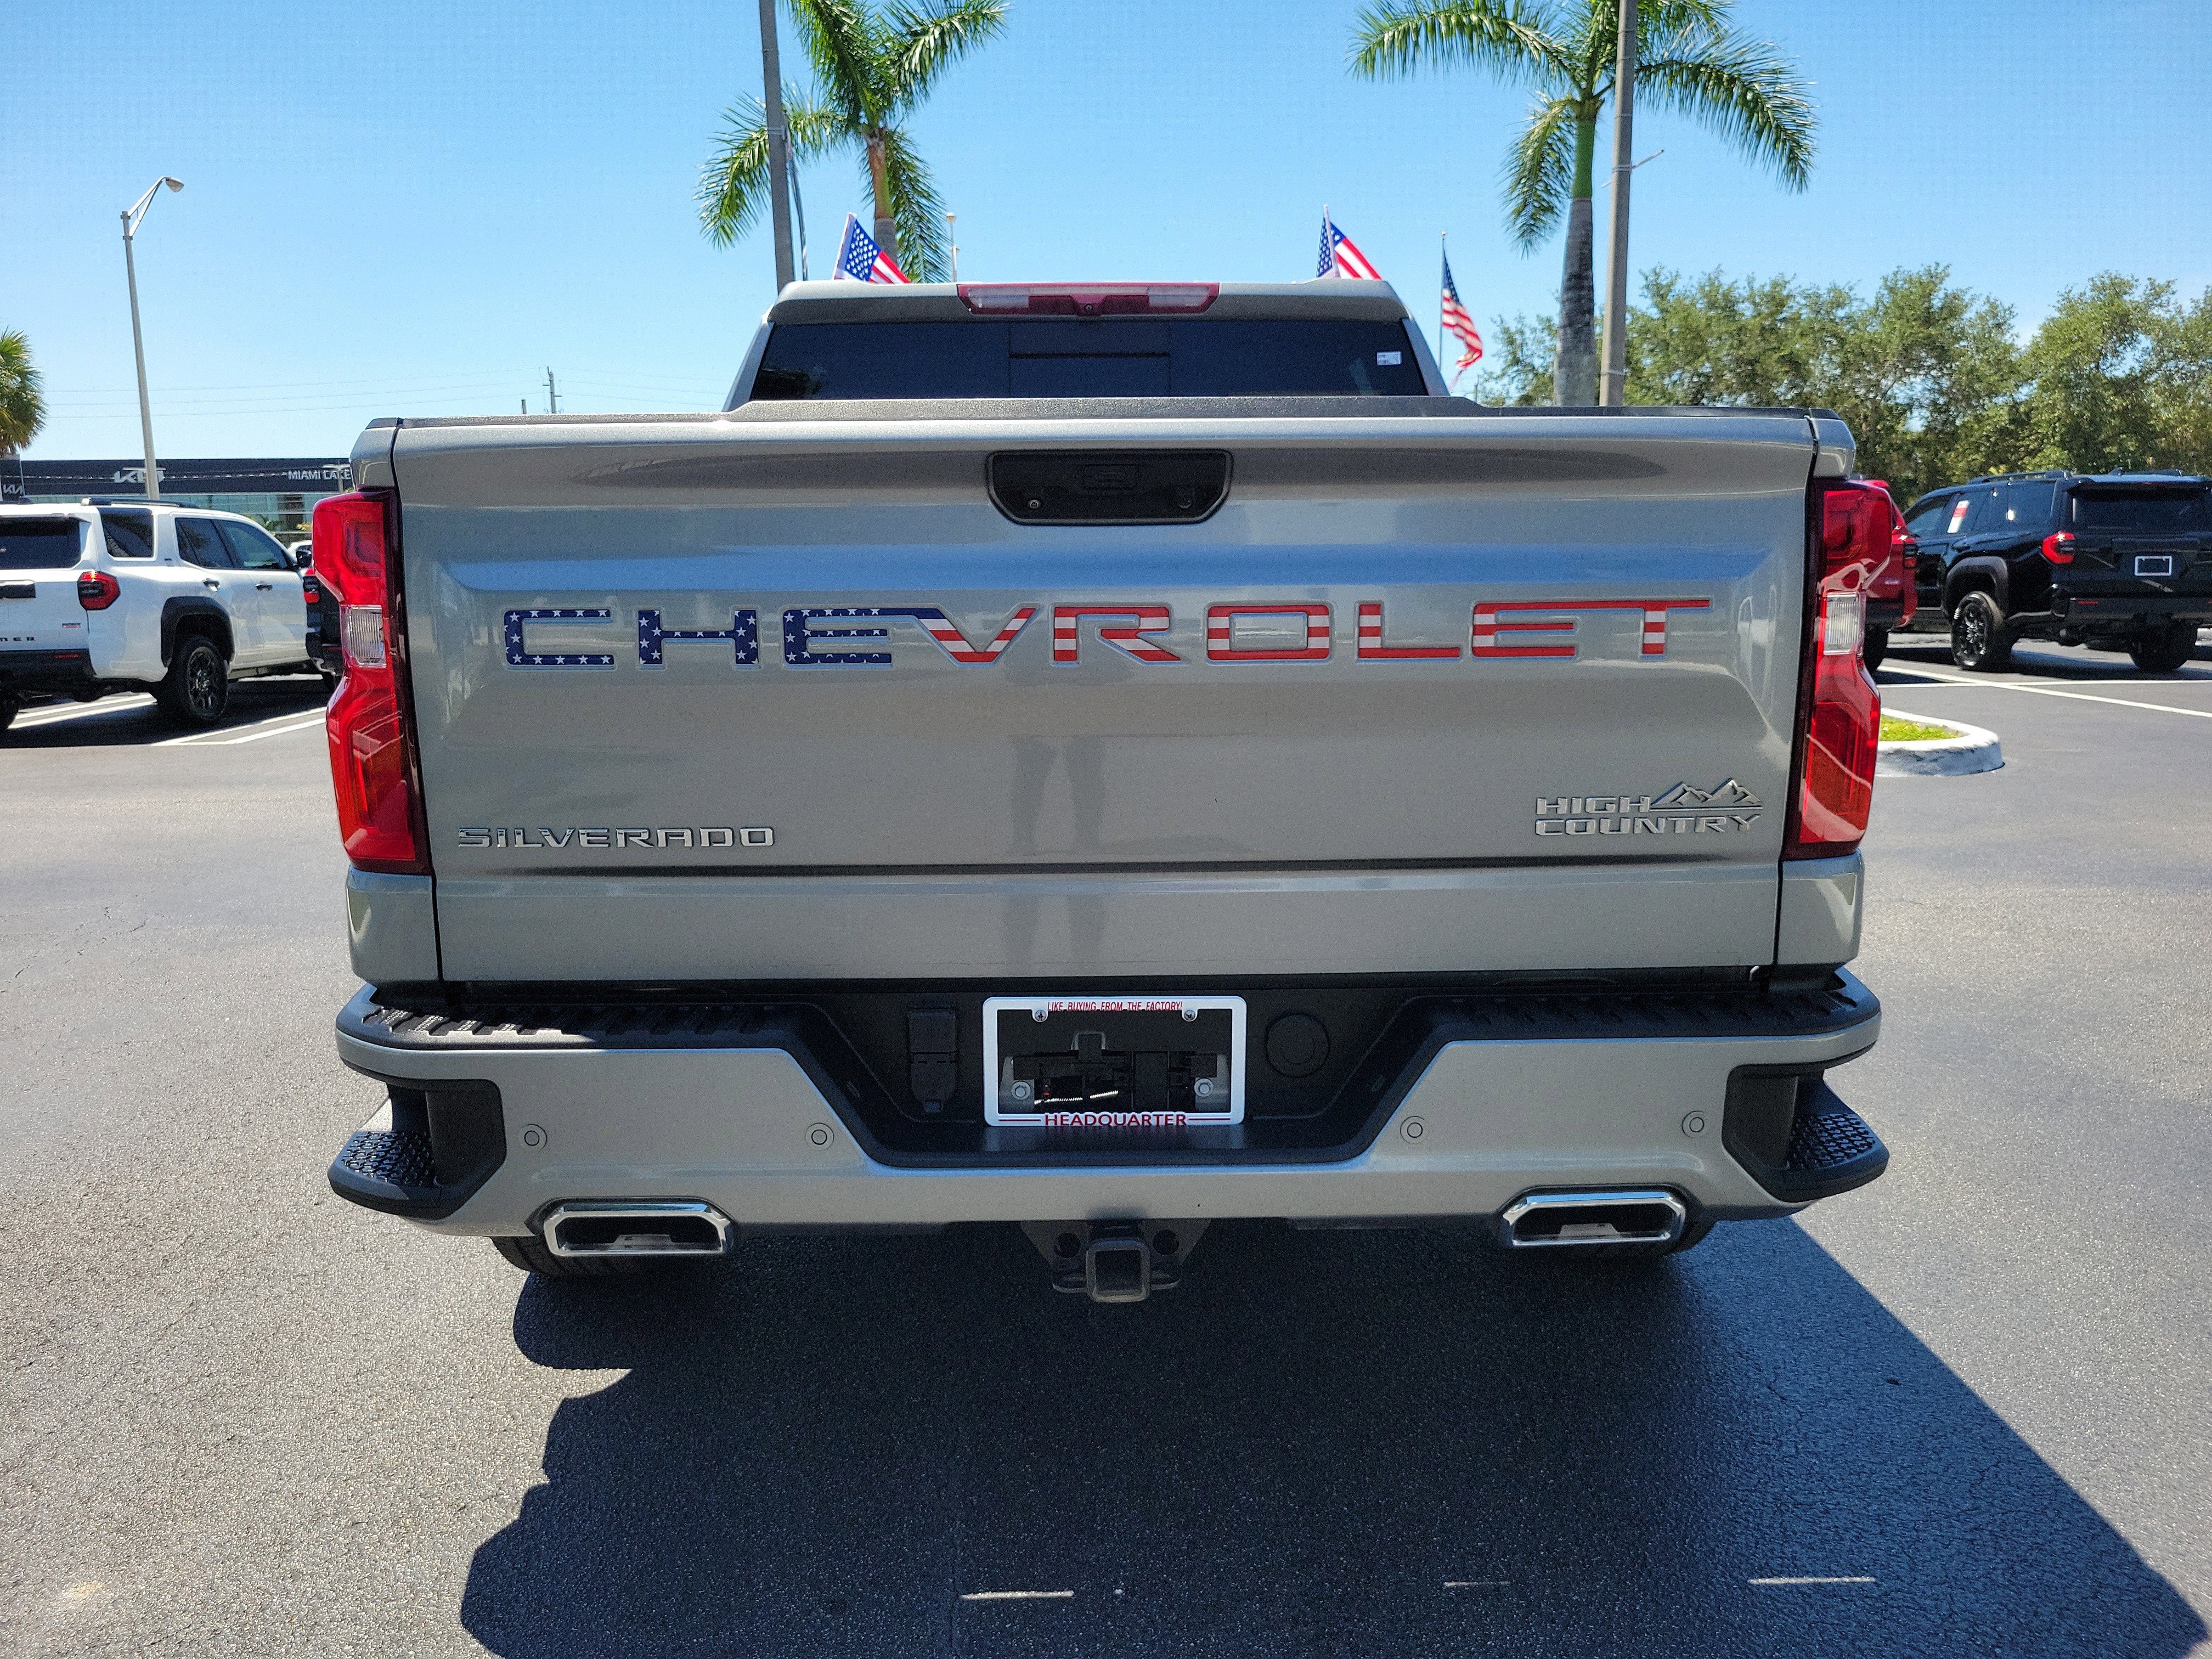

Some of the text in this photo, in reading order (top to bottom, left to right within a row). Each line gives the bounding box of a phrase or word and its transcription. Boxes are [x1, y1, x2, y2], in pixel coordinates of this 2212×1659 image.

[288, 470, 321, 480] MIAMI
[503, 598, 1711, 667] CHEVROLET
[1536, 795, 1651, 815] HIGH
[1535, 814, 1761, 836] COUNTRY
[457, 827, 776, 848] SILVERADO
[1047, 1001, 1183, 1012] LIKE BUYING FROM THE FACTORY!
[1045, 1114, 1187, 1126] HEADQUARTER
